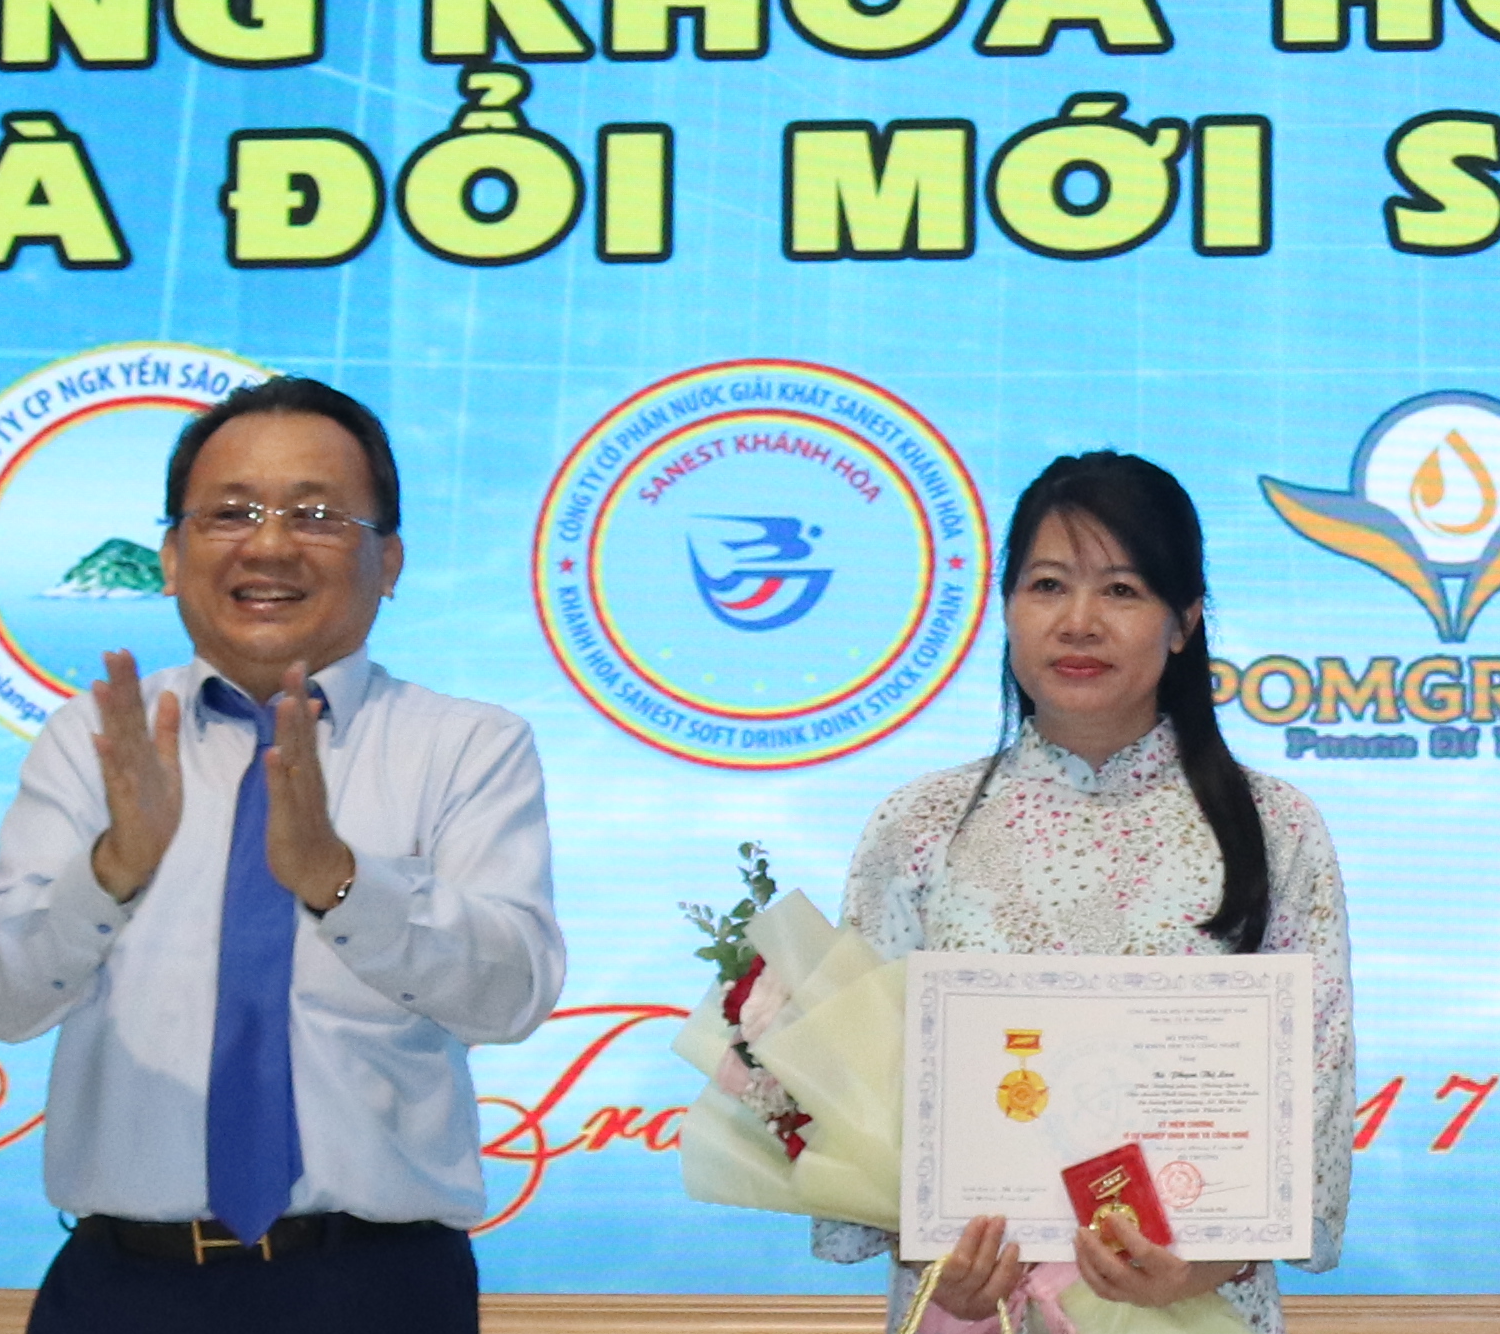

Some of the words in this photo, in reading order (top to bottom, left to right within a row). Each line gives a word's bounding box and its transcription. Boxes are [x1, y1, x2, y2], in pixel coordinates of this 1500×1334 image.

[220, 62, 674, 269] ĐỔI
[782, 89, 1270, 263] MỚI
[21, 387, 54, 422] CP
[57, 369, 114, 403] NGK
[118, 352, 172, 388] YẾN
[177, 361, 231, 398] SÀO
[832, 395, 903, 446] SANEST
[639, 438, 726, 506] SANEST
[734, 431, 832, 465] KHÁNH
[832, 455, 882, 505] HÒA
[557, 584, 598, 649] KHANH
[587, 646, 620, 692] HOA
[614, 680, 686, 734] SANEST
[685, 720, 739, 749] SOFT
[740, 726, 808, 749] DRINK
[810, 703, 870, 746] JOINT
[868, 662, 923, 717] STOCK
[912, 582, 966, 671] COMPANY
